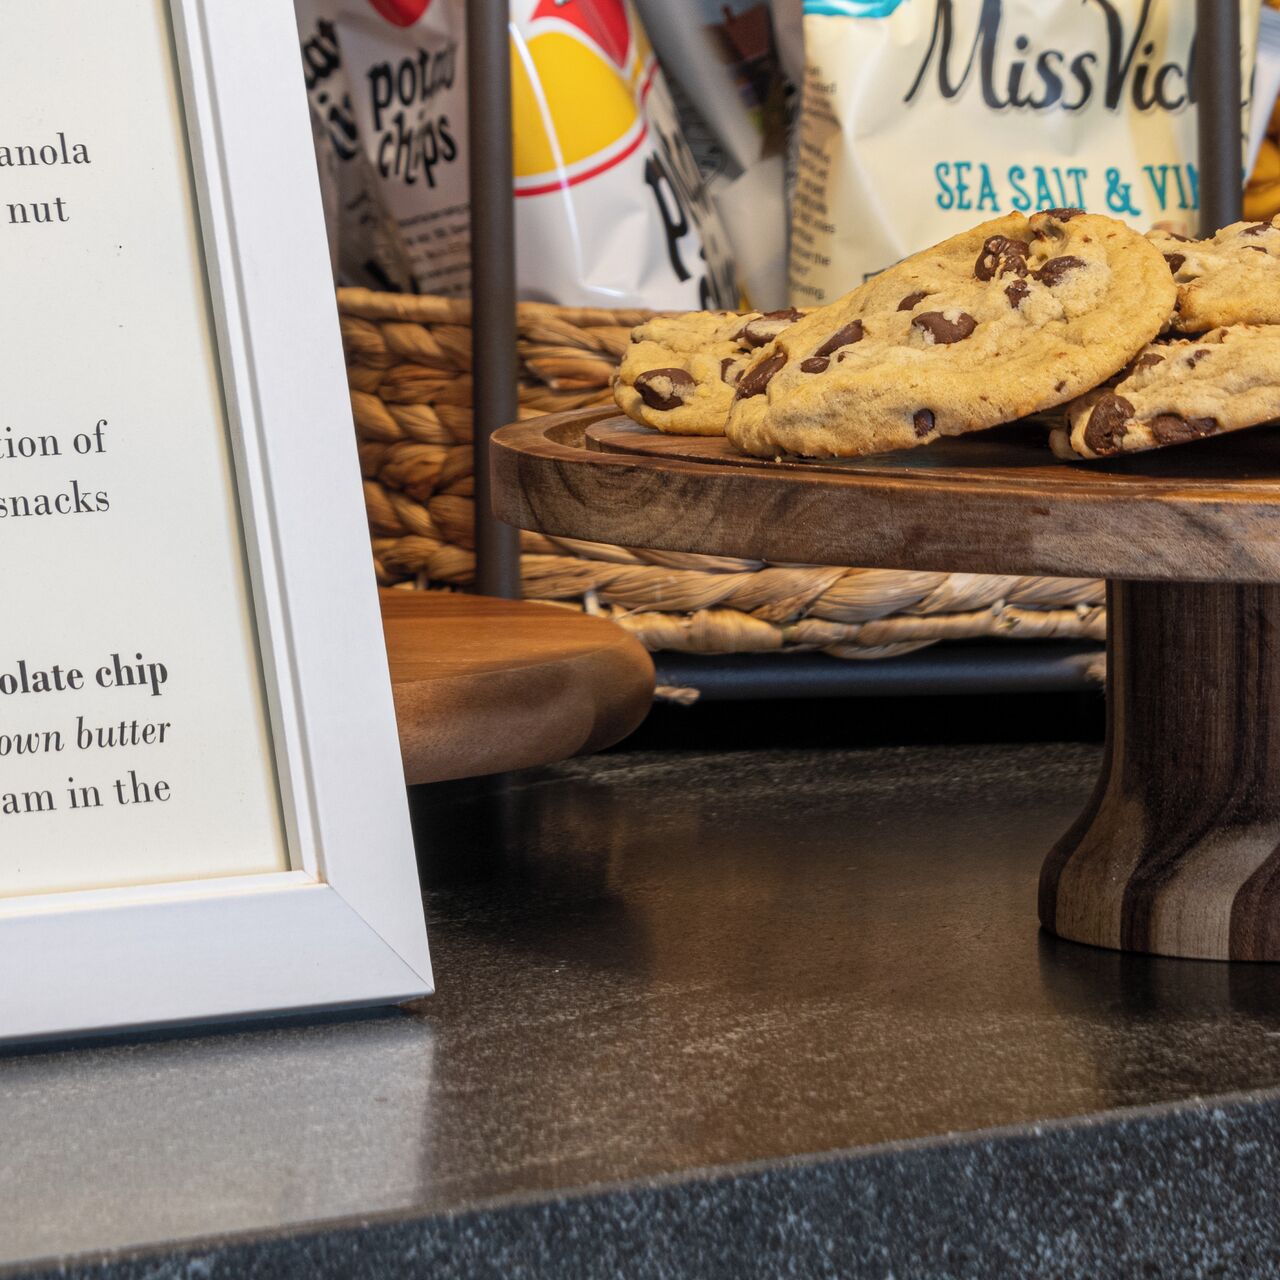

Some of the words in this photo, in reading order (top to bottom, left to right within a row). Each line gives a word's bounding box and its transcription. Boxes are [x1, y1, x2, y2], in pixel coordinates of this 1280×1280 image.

[935, 161, 1000, 212] SEA
[1008, 165, 1088, 212] SALT
[1104, 167, 1141, 216] &
[5, 197, 70, 224] nut
[72, 418, 108, 455] of
[95, 652, 168, 697] chip
[75, 715, 172, 750] butter
[66, 776, 104, 809] in
[112, 769, 172, 805] the
